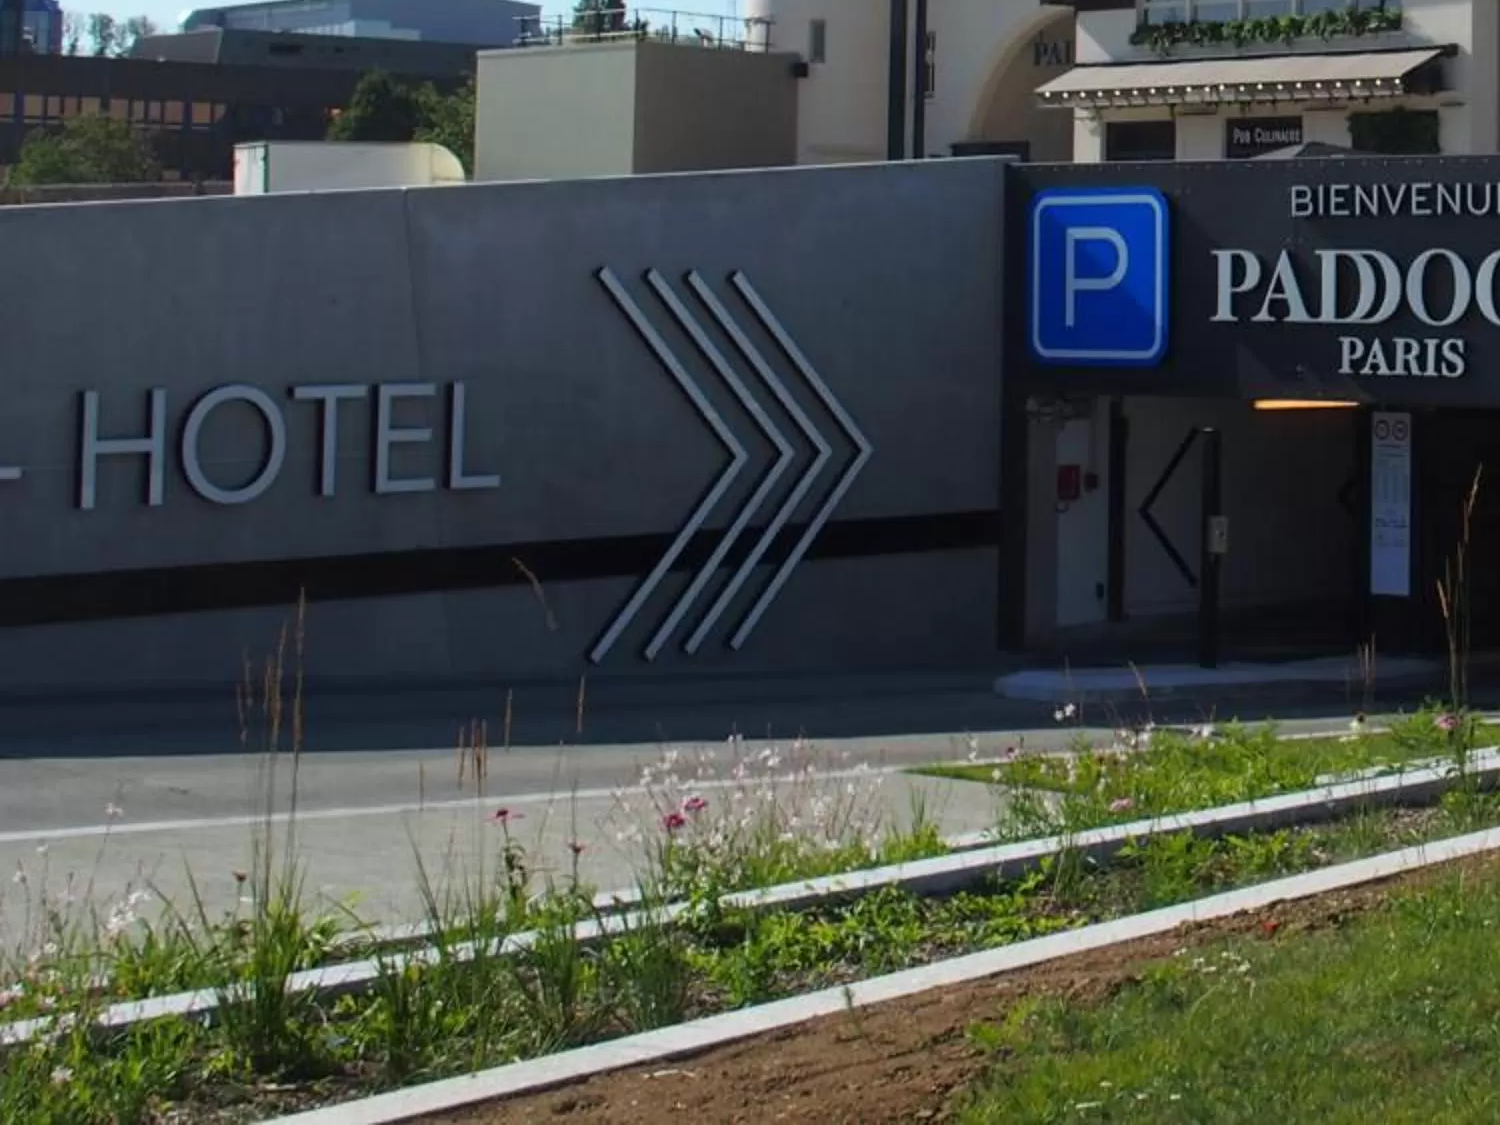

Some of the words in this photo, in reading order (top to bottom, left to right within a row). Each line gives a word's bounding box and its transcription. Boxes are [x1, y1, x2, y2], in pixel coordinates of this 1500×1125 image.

[1065, 227, 1129, 328] P
[1338, 338, 1467, 378] PARIS
[79, 381, 500, 509] HOTEL
